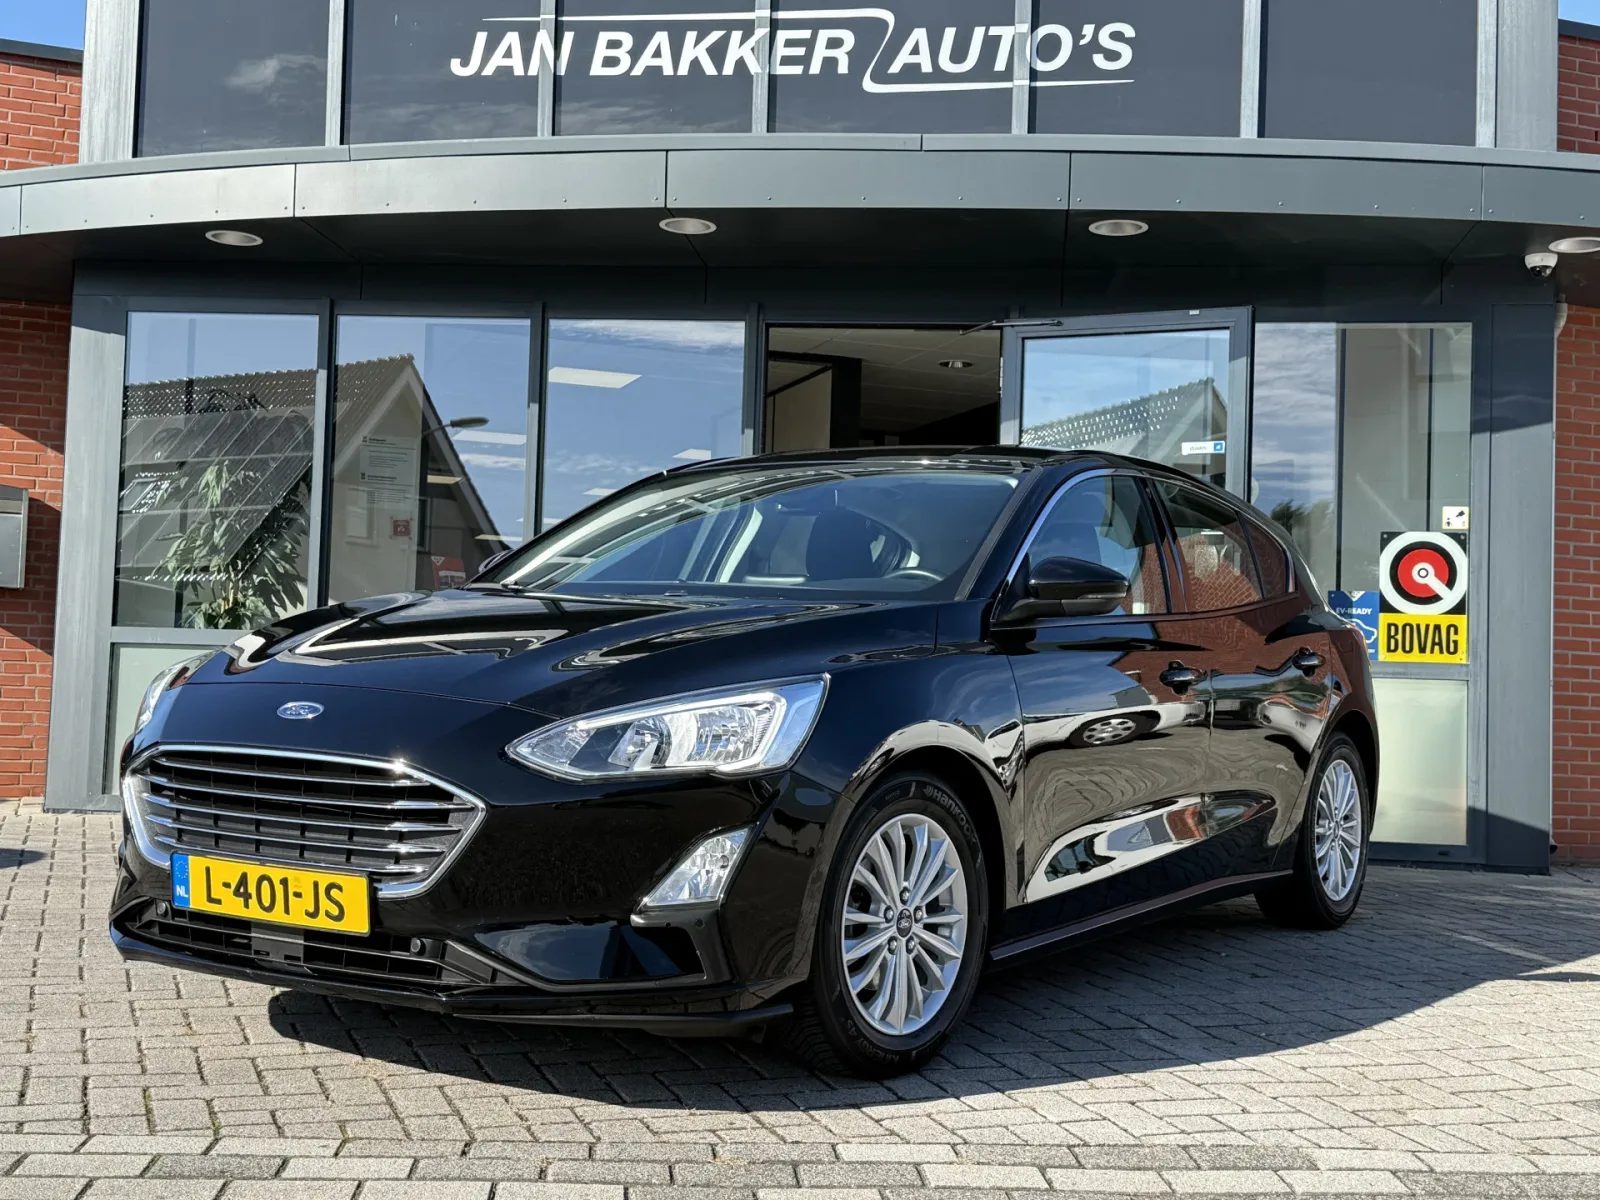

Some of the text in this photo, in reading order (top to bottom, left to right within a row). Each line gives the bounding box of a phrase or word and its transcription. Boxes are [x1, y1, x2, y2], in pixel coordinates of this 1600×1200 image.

[450, 22, 1136, 76] JAN BAKKER AUTO'S
[1335, 606, 1373, 615] EV-READY
[1386, 622, 1459, 656] BOVAG
[175, 885, 189, 898] NL
[204, 865, 346, 923] L-401-JS
